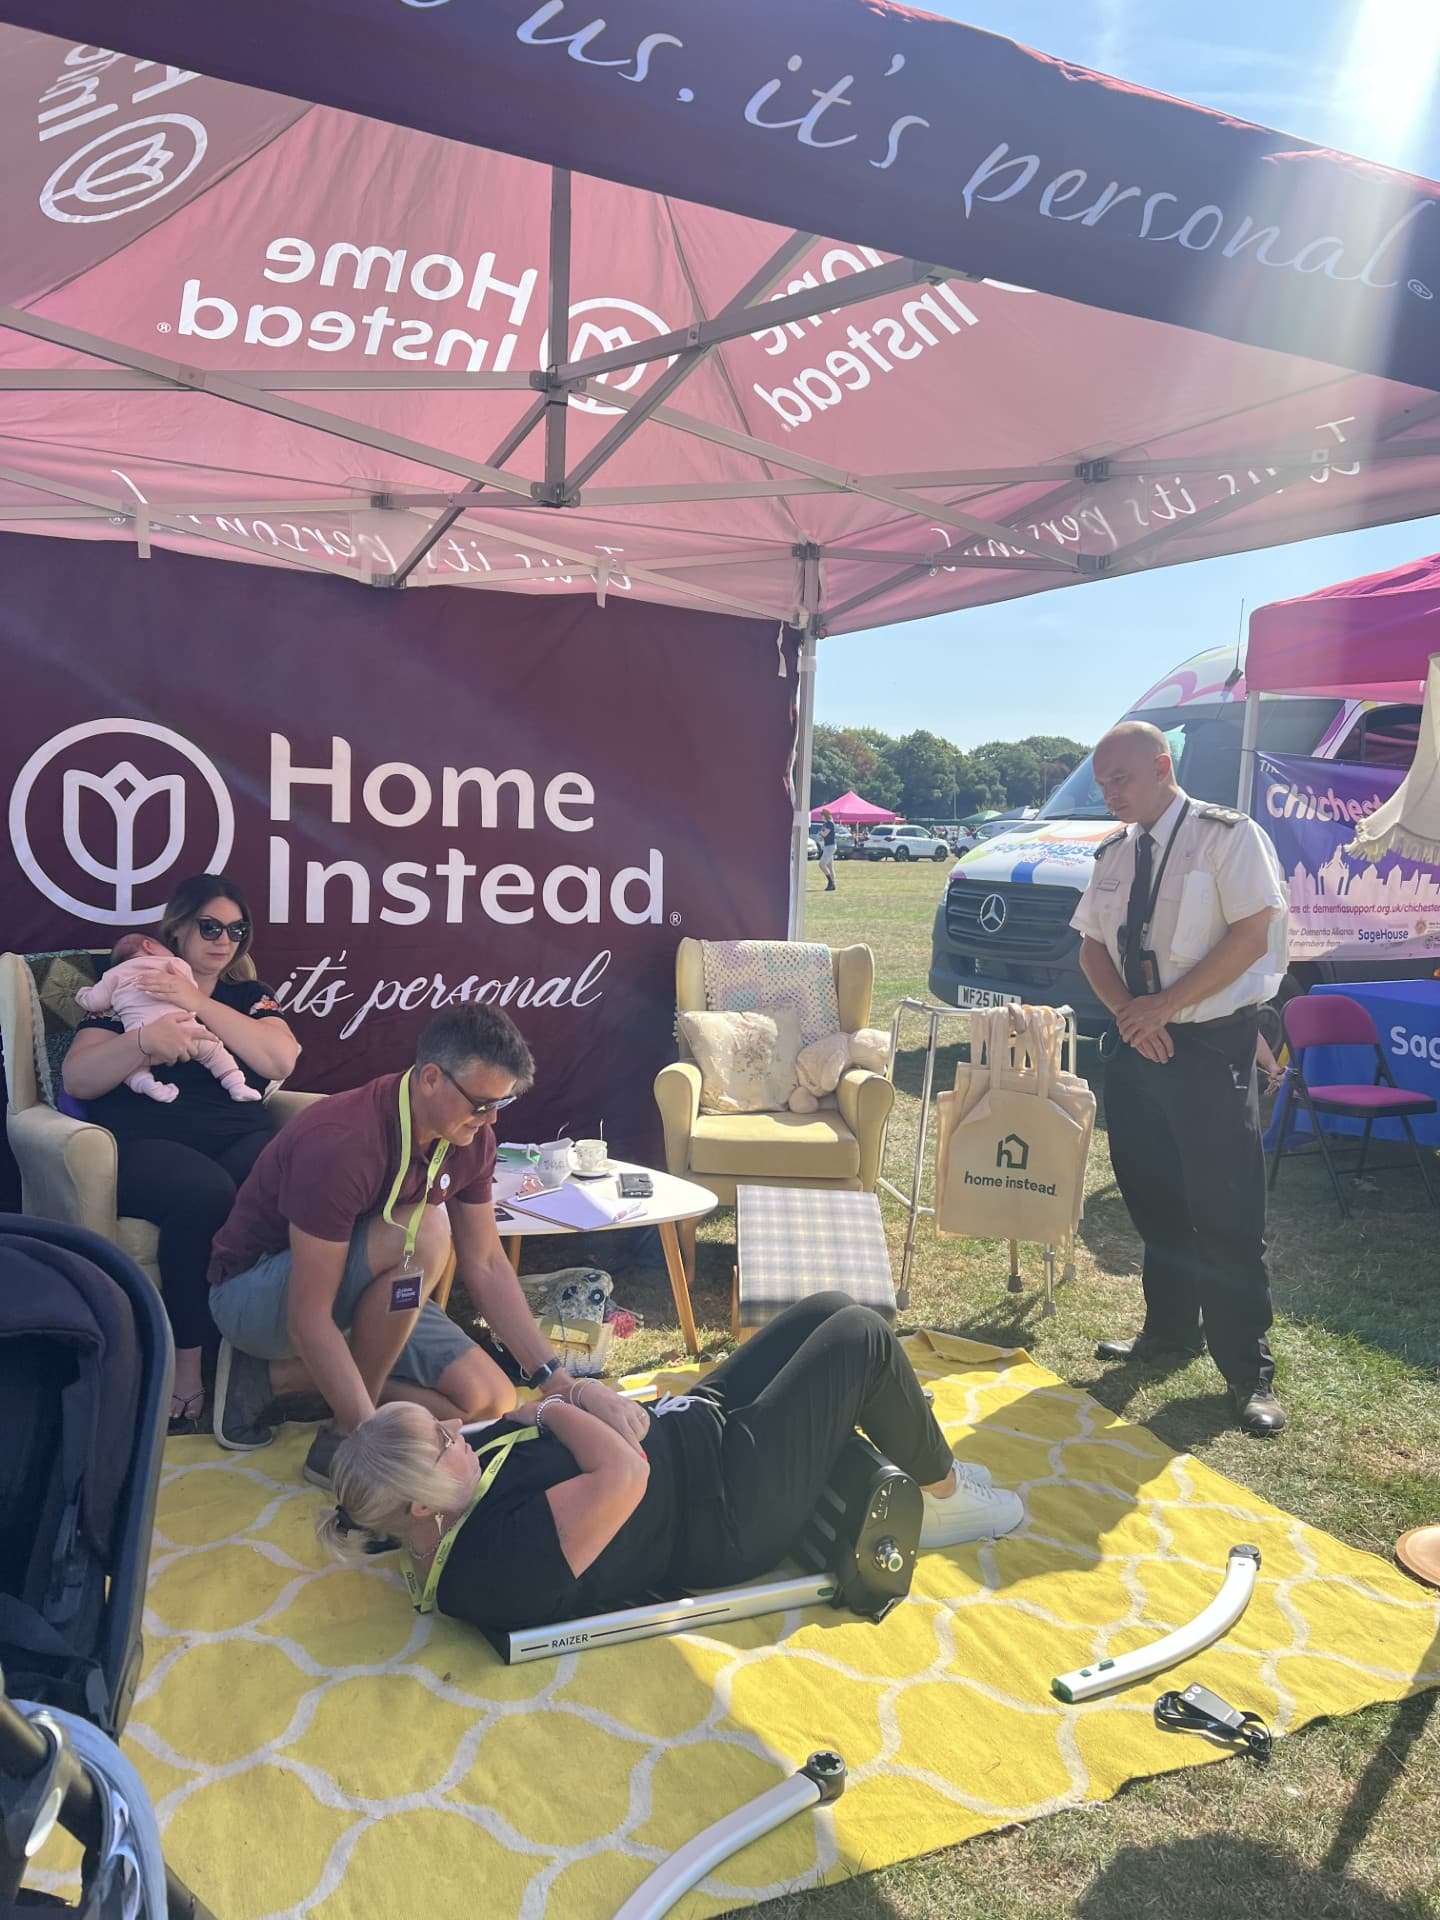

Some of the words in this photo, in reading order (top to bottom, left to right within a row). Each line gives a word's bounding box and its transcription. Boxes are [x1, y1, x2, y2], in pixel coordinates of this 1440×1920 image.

[744, 53, 930, 170] it's
[269, 732, 595, 832] Home
[1358, 928, 1409, 943] SageHouse
[274, 950, 354, 1018] it's
[340, 949, 611, 1040] personal
[964, 1171, 1003, 1188] home
[1005, 1176, 1058, 1196] instead
[551, 1633, 589, 1649] RAIZER
